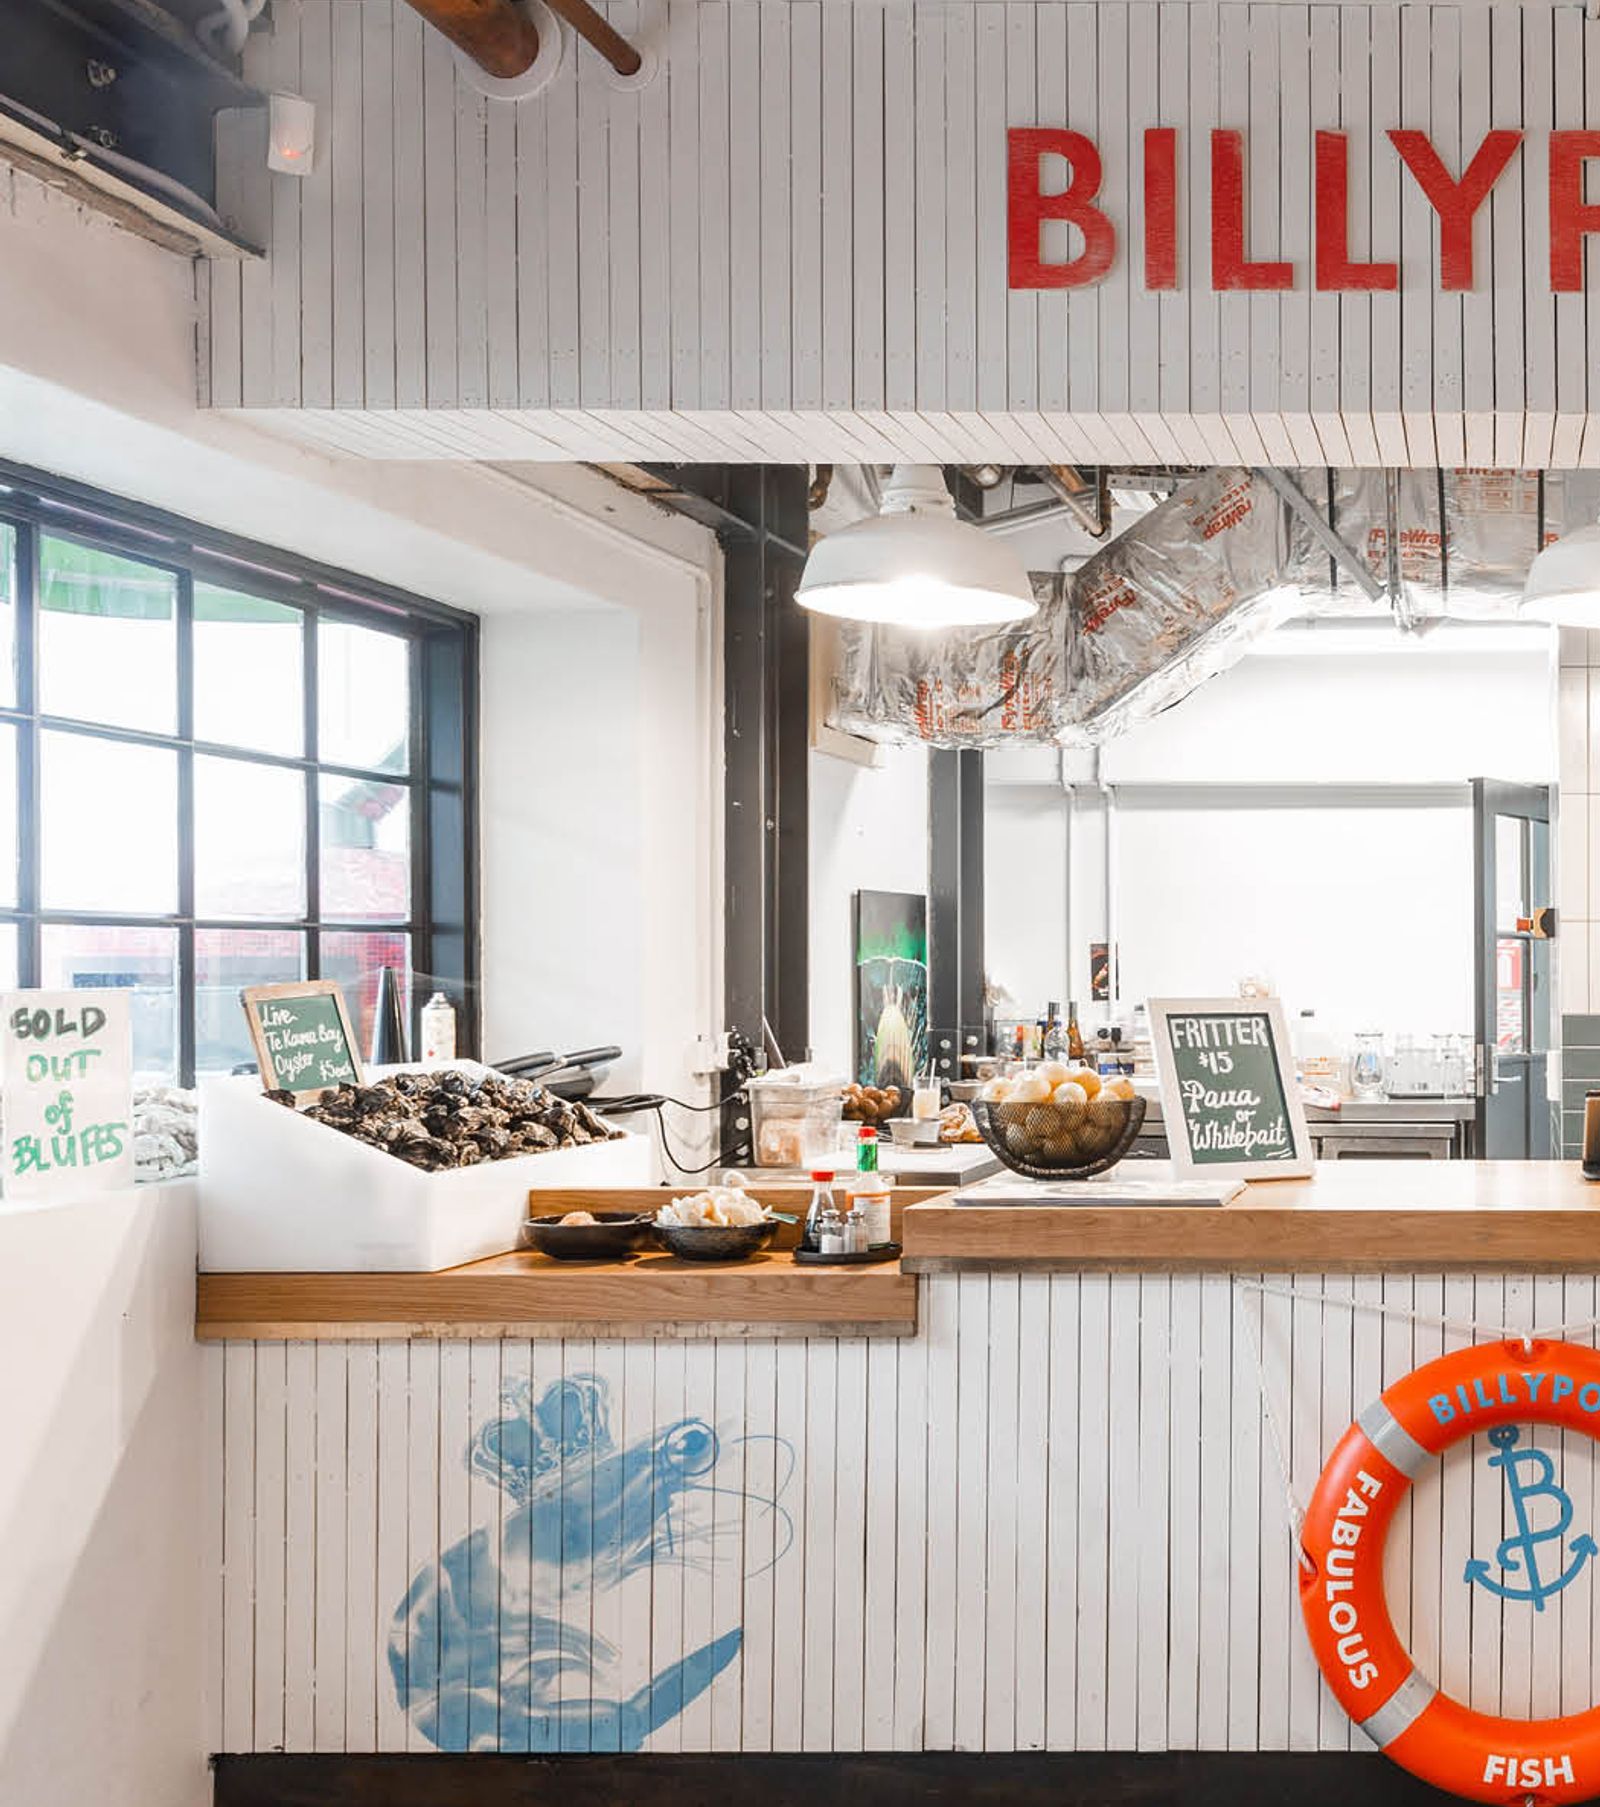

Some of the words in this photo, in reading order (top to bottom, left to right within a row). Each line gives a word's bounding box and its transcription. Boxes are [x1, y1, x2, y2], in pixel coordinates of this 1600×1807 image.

[10, 1007, 106, 1040] SOLD
[263, 1005, 298, 1027] Live
[1169, 1016, 1270, 1049] FRITTER
[26, 1049, 102, 1083] OUT
[1198, 1051, 1234, 1075] $15
[44, 1089, 74, 1136] of
[1182, 1080, 1262, 1113] Paua
[1235, 1109, 1257, 1123] or
[1188, 1116, 1288, 1157] Whitebait
[1325, 1470, 1382, 1689] FABULOUS
[1482, 1754, 1575, 1787] FISH
